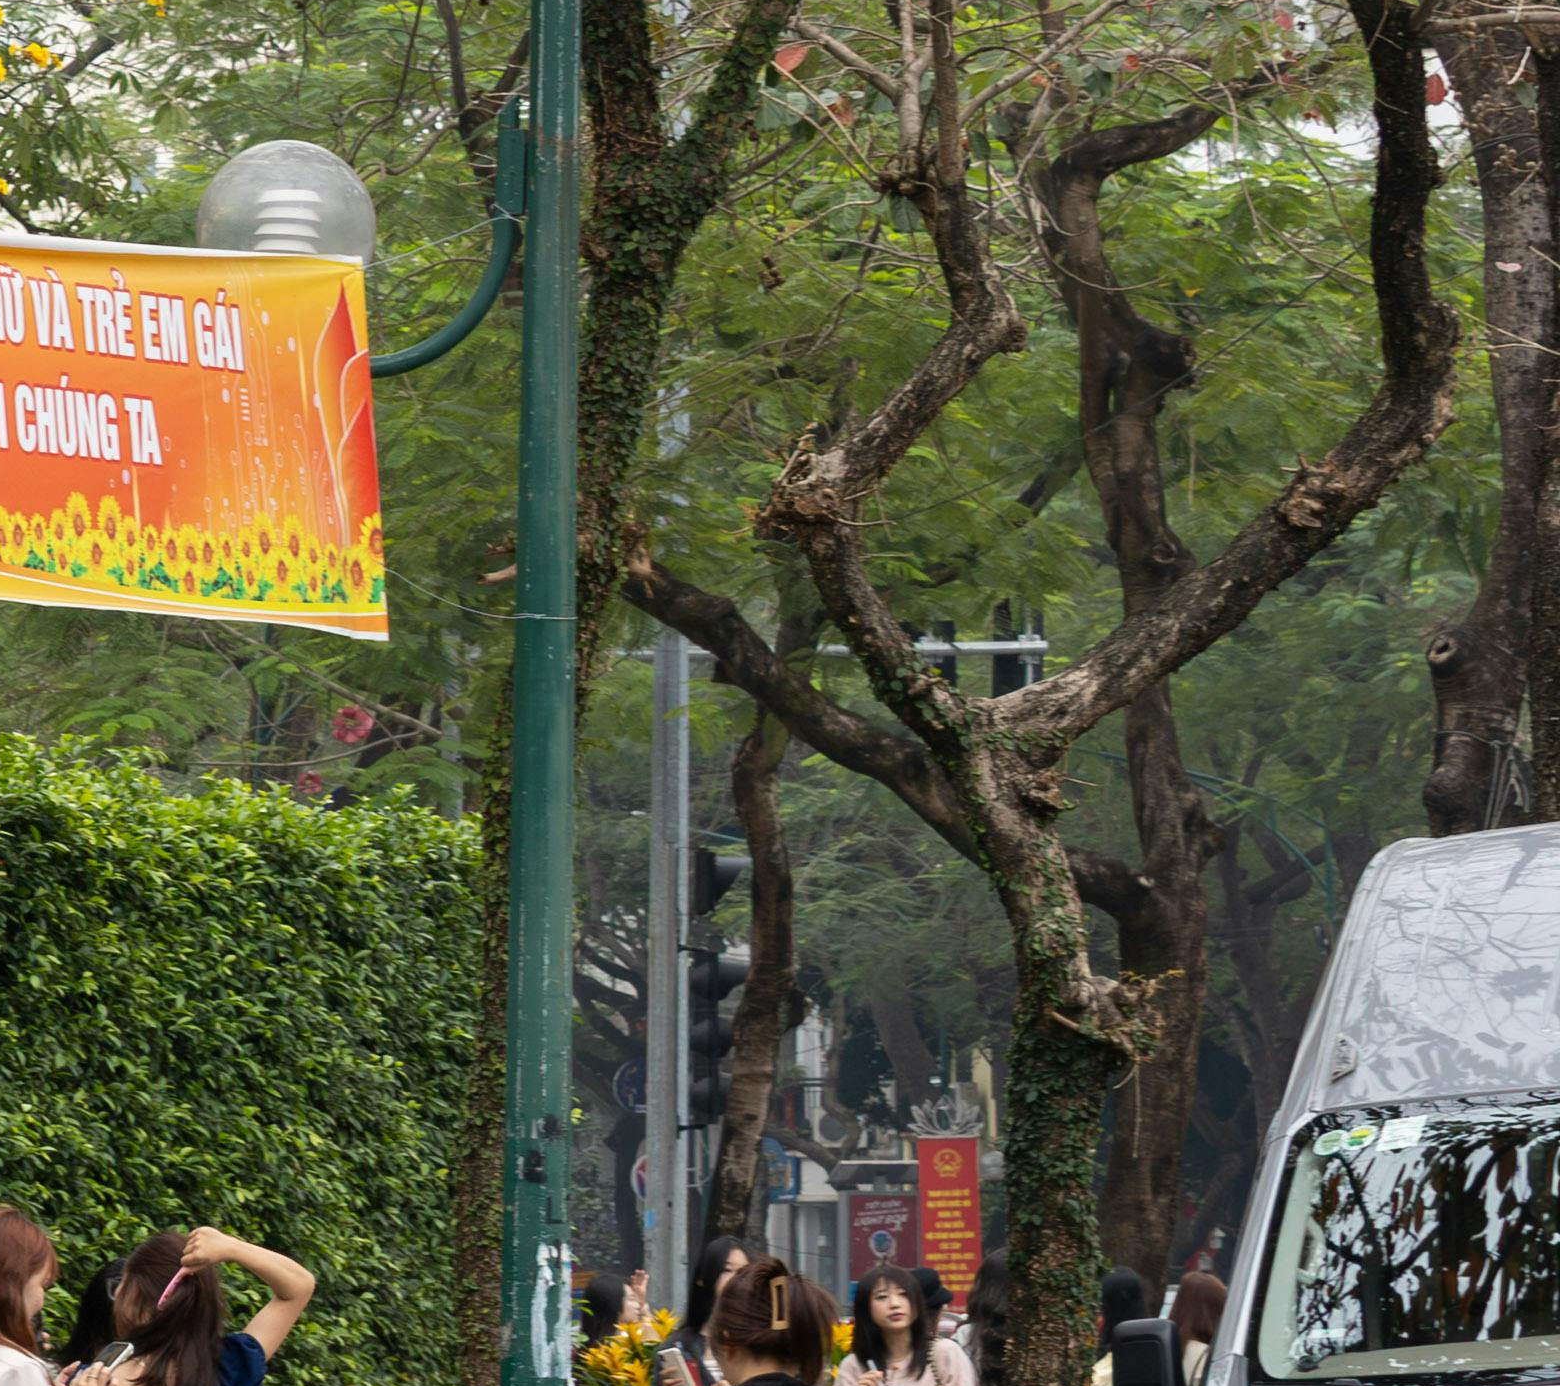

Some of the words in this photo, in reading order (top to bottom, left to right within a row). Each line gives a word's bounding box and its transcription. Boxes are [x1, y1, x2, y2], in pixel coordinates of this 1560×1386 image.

[27, 267, 75, 350] VÀ
[75, 268, 136, 358] TRẺ
[139, 293, 189, 364] EM
[193, 289, 245, 371] GÁI
[14, 374, 121, 461] CHÚNG
[123, 396, 163, 465] TA
